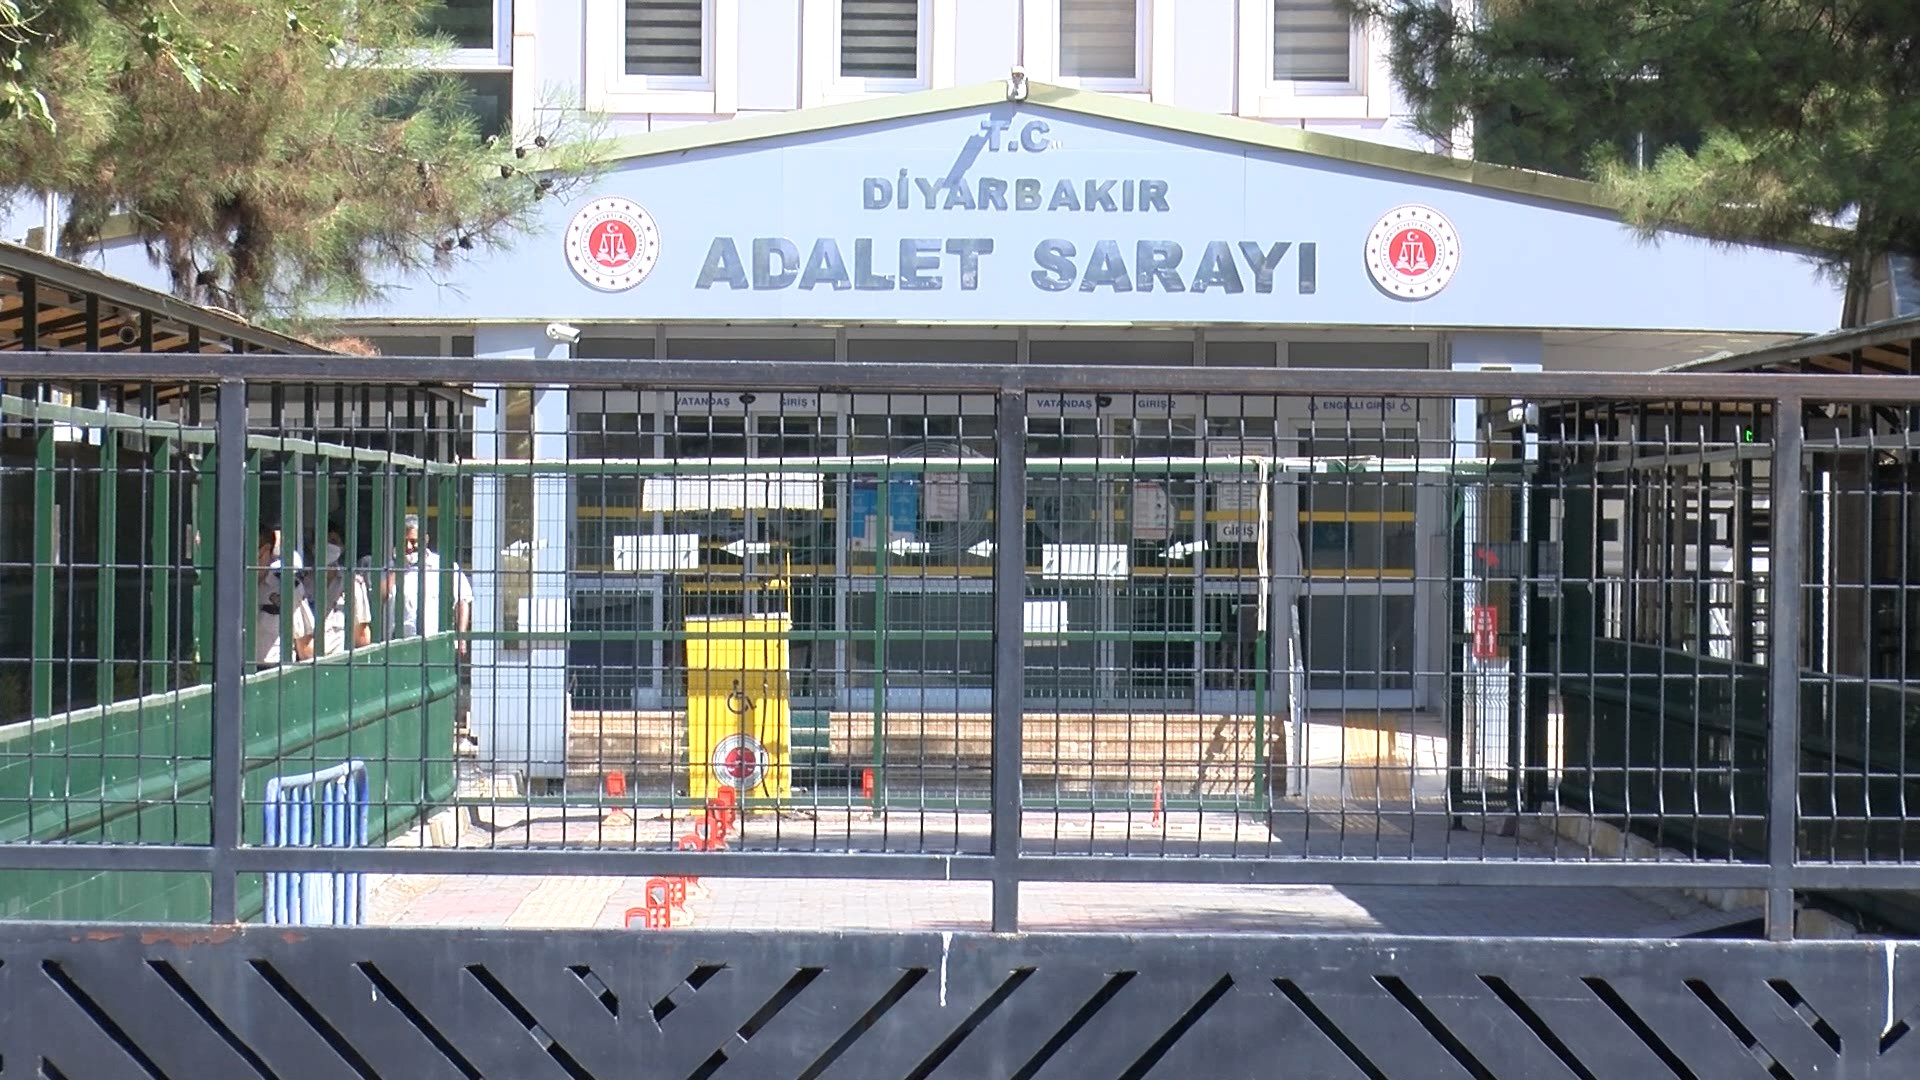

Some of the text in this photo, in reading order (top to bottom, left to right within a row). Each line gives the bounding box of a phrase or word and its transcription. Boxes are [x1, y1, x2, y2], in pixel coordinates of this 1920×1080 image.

[862, 168, 1171, 212] DİYARBAKIR
[695, 236, 995, 292] ADALET
[1030, 238, 1317, 295] SARAYI
[1037, 400, 1092, 410] VATANDAŞ
[1137, 399, 1168, 410] GİRİŞ
